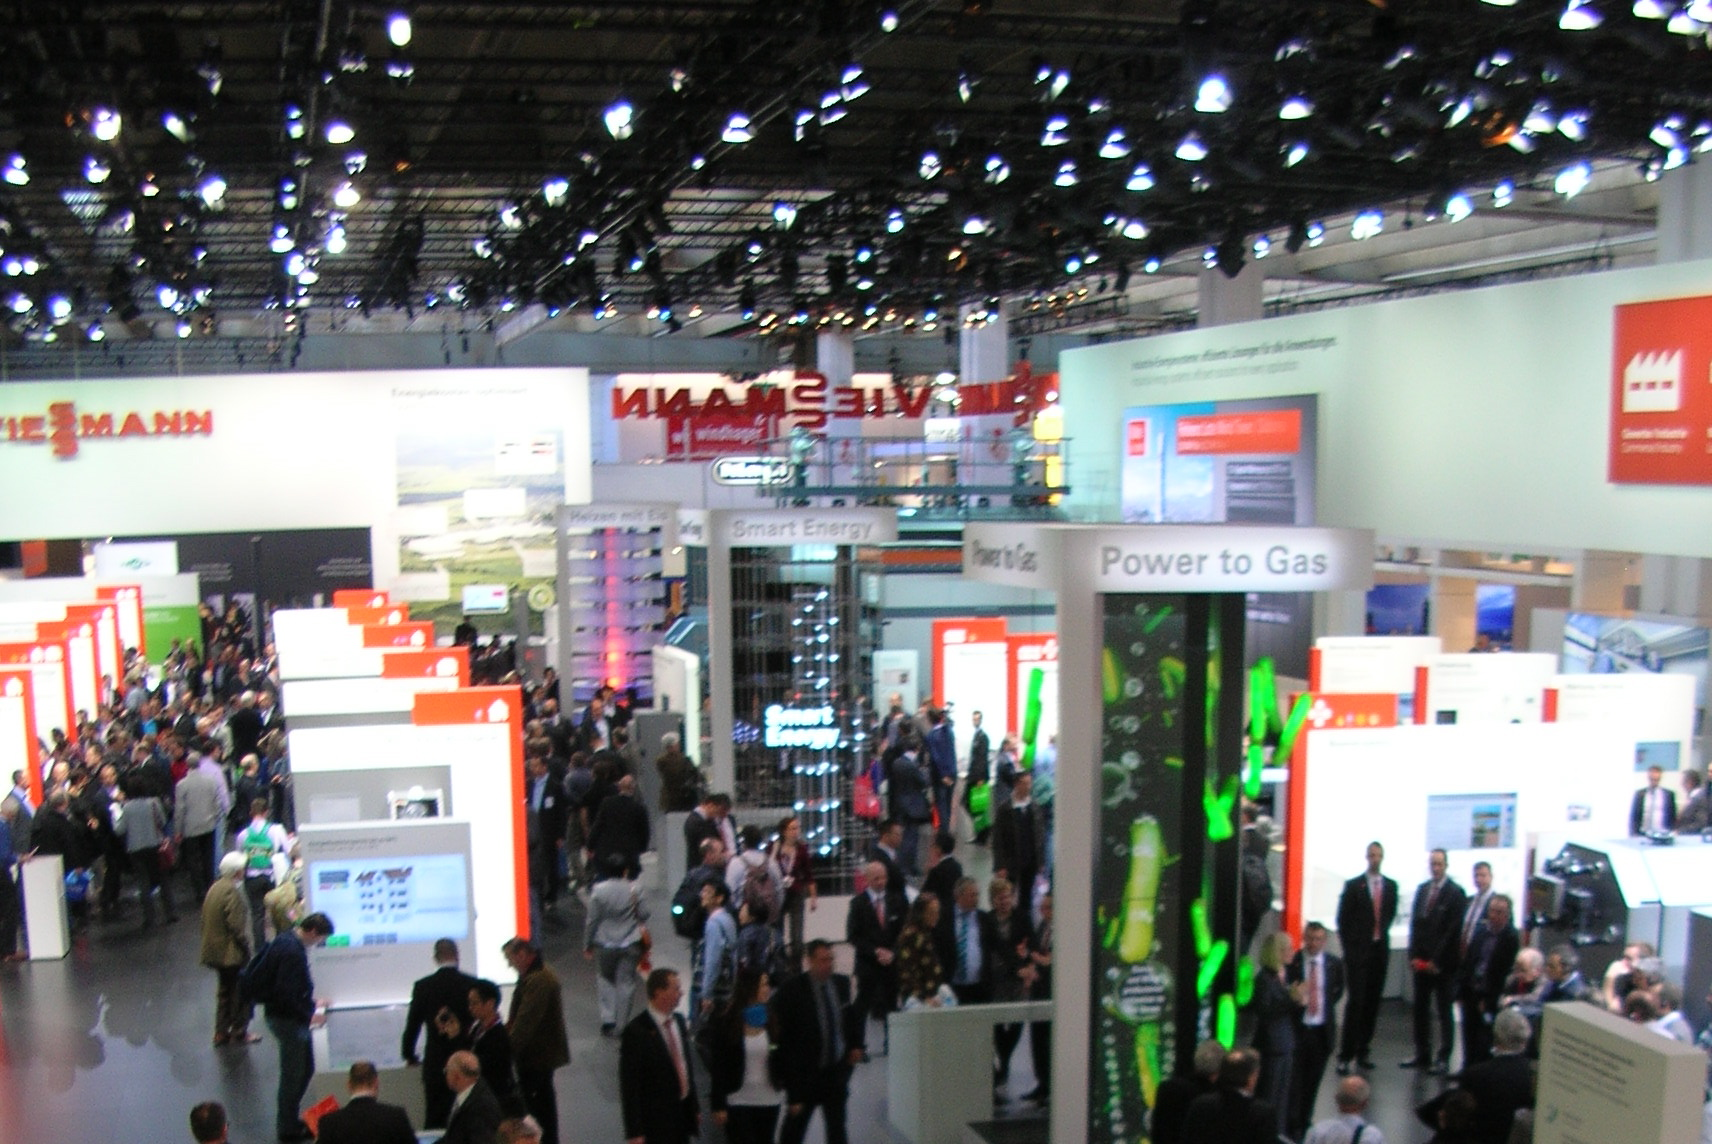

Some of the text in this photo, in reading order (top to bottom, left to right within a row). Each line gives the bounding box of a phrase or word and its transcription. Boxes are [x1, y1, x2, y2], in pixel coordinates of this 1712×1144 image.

[0, 401, 213, 459] IESSMANN
[732, 517, 875, 541] Smart Energy
[972, 539, 1001, 568] Power
[1016, 542, 1038, 573] Gas
[1100, 545, 1329, 576] Power to Gas
[765, 704, 834, 726] Smart
[765, 726, 841, 750] Energy
